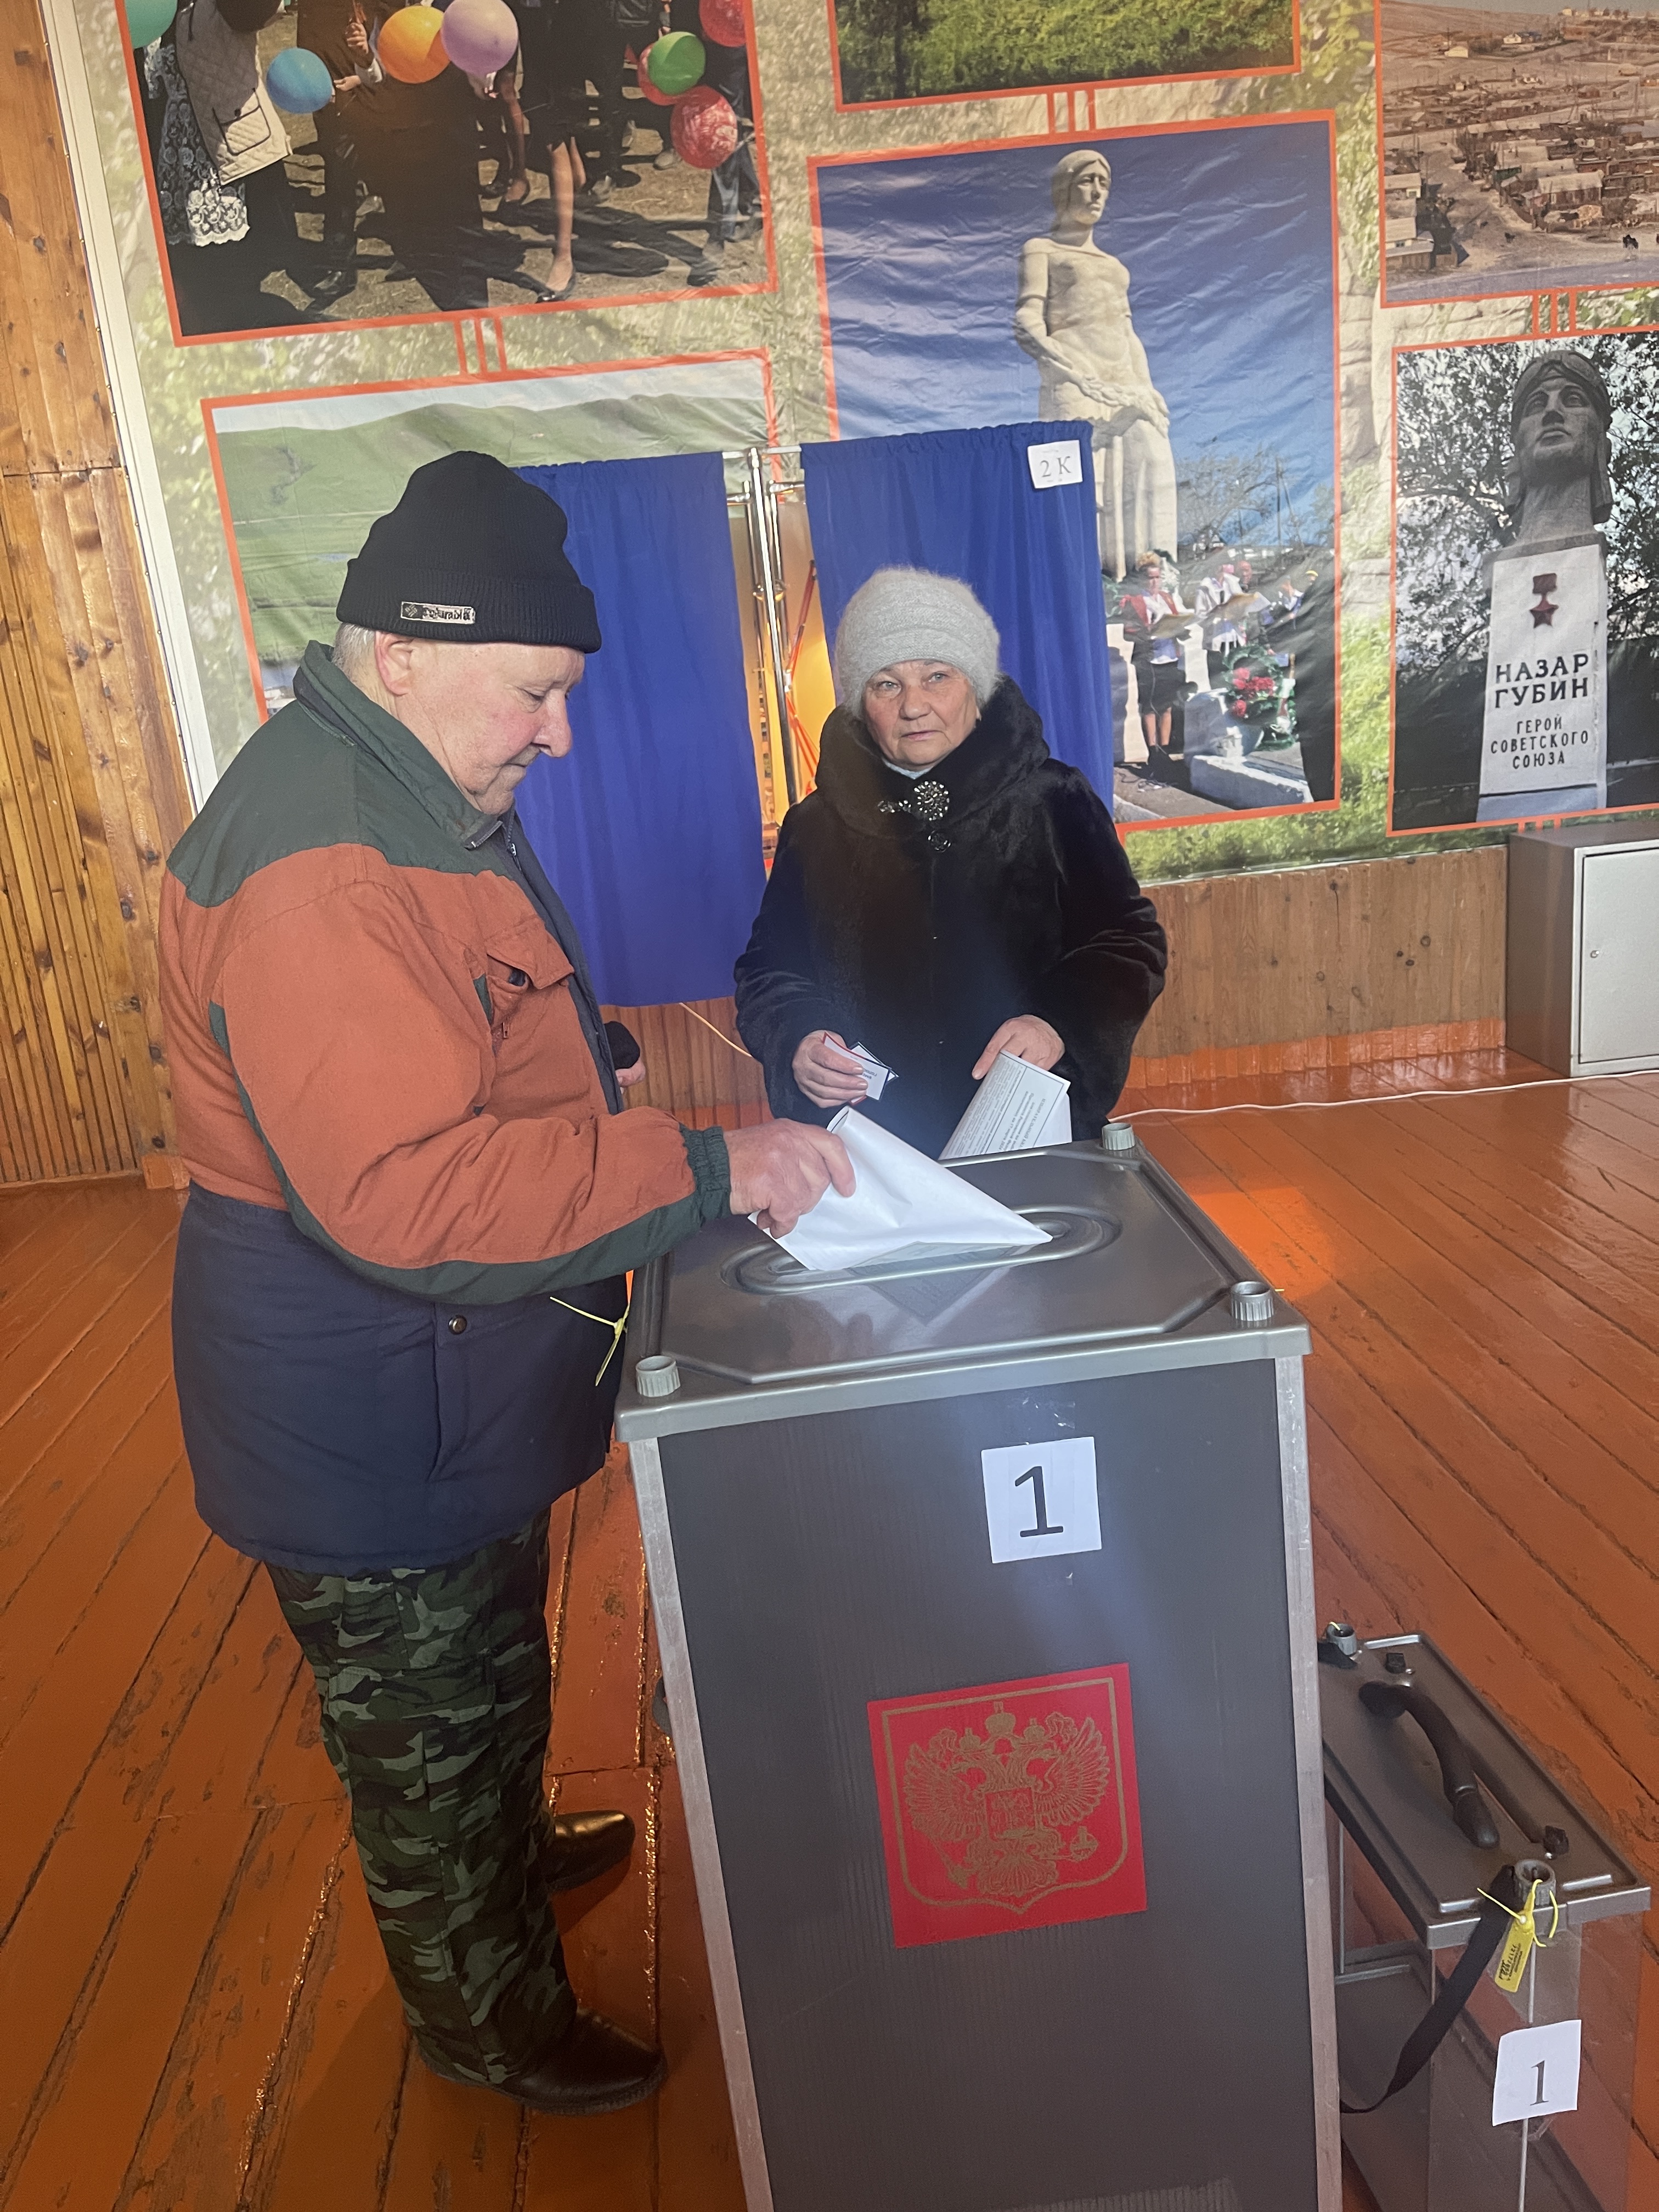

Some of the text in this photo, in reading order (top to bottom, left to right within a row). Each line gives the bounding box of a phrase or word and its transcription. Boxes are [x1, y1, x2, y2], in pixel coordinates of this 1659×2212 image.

[1040, 460, 1052, 478] 2
[1496, 653, 1589, 684] НАЗАР
[1495, 677, 1588, 708] ГУБИН
[1517, 715, 1562, 735] ГЕРОЙ
[1491, 730, 1589, 754] СОВЕТСКОГО
[1513, 751, 1565, 769] СОЮЗА
[1015, 1466, 1063, 1537] 1
[1530, 2060, 1549, 2106] 1
